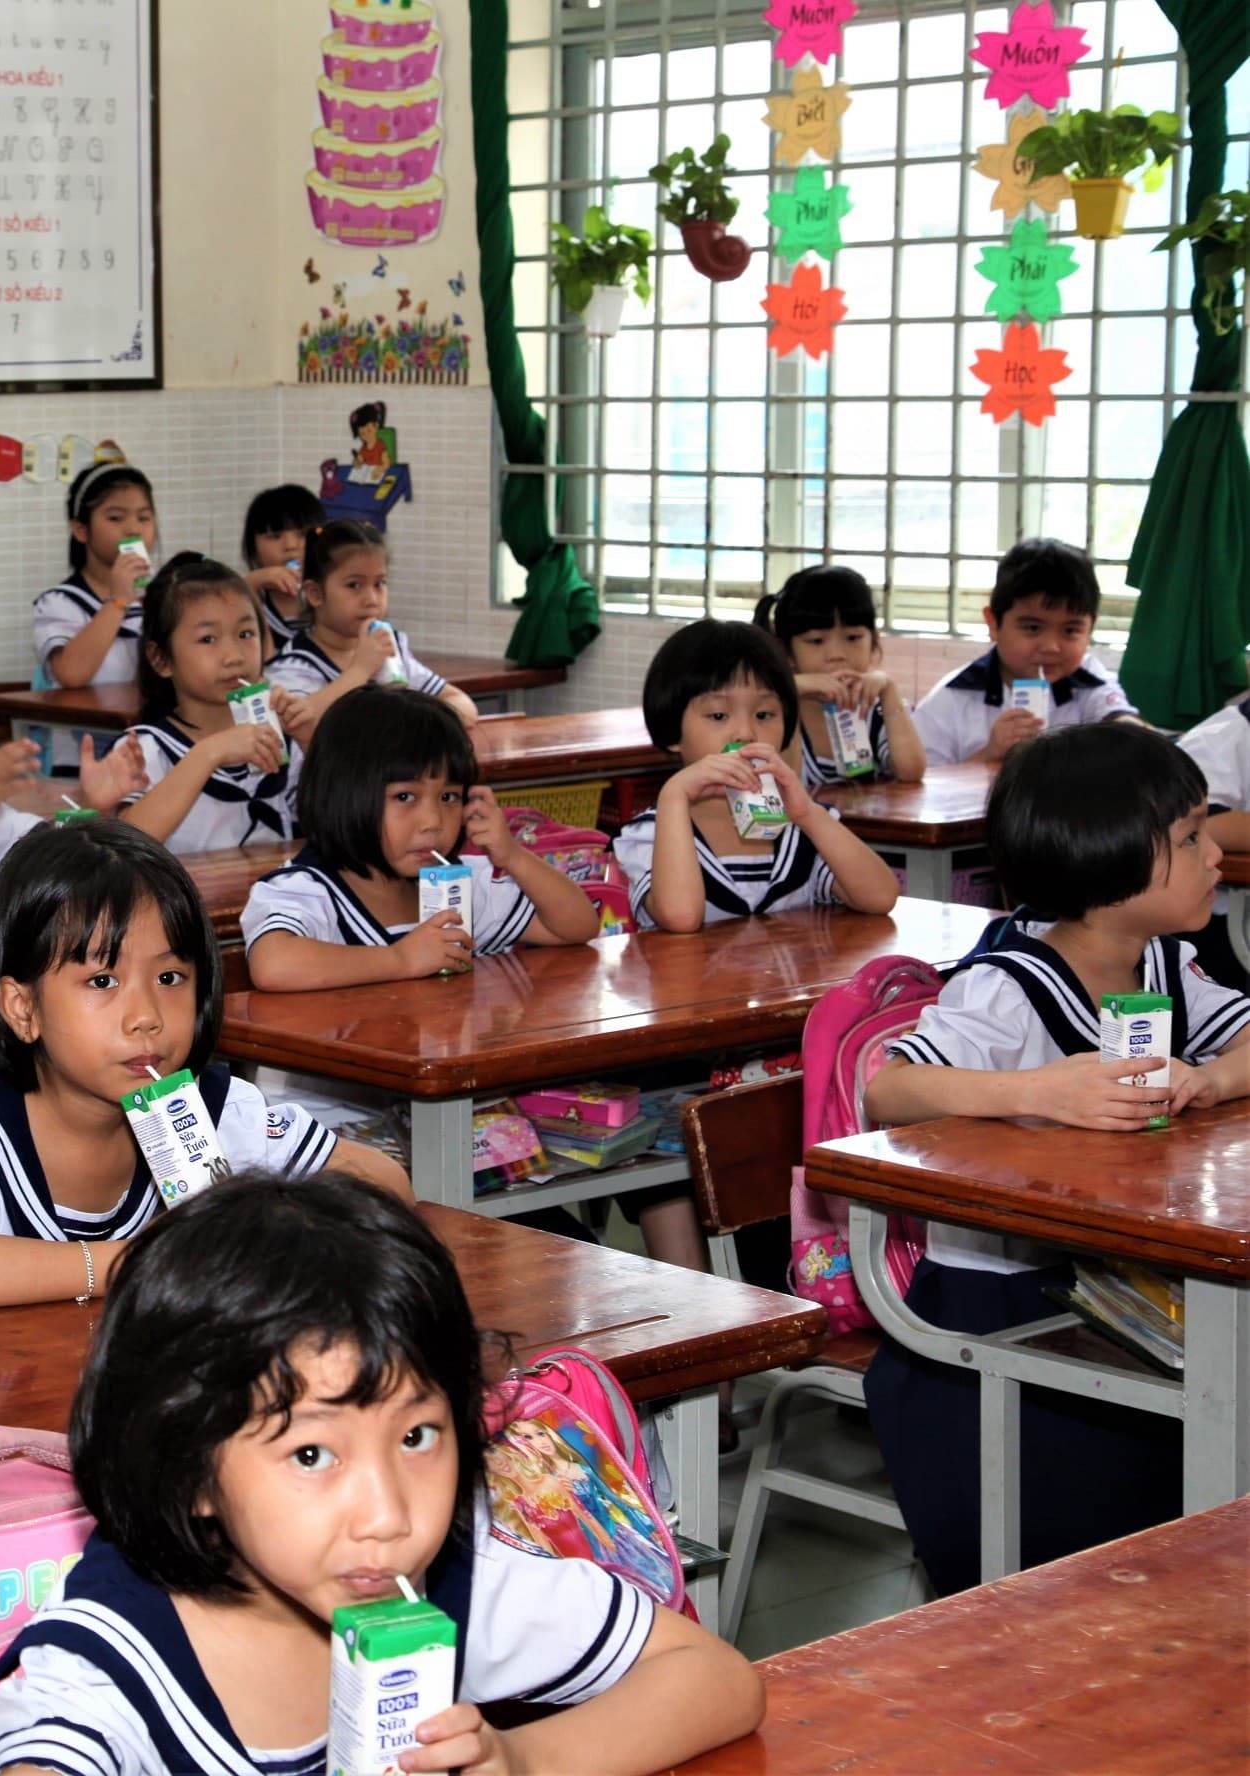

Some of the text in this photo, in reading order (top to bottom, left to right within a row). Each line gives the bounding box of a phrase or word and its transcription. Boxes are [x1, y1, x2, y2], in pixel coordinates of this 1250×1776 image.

[1001, 35, 1060, 67] Muốn
[7, 249, 17, 270] 5
[31, 249, 41, 271] 6
[57, 249, 66, 270] 7
[80, 249, 91, 270] 8
[103, 249, 115, 270] 9
[1010, 254, 1048, 281] Phải
[10, 313, 20, 334] 7
[1004, 360, 1037, 389] Học
[1131, 1035, 1150, 1044] 100%
[1129, 1046, 1145, 1055] Sữa
[173, 1115, 197, 1130] 100%
[179, 1131, 196, 1143] Sữa
[183, 1135, 209, 1154] Tươi
[380, 1694, 418, 1713] 100%
[377, 1717, 406, 1733] Sữa
